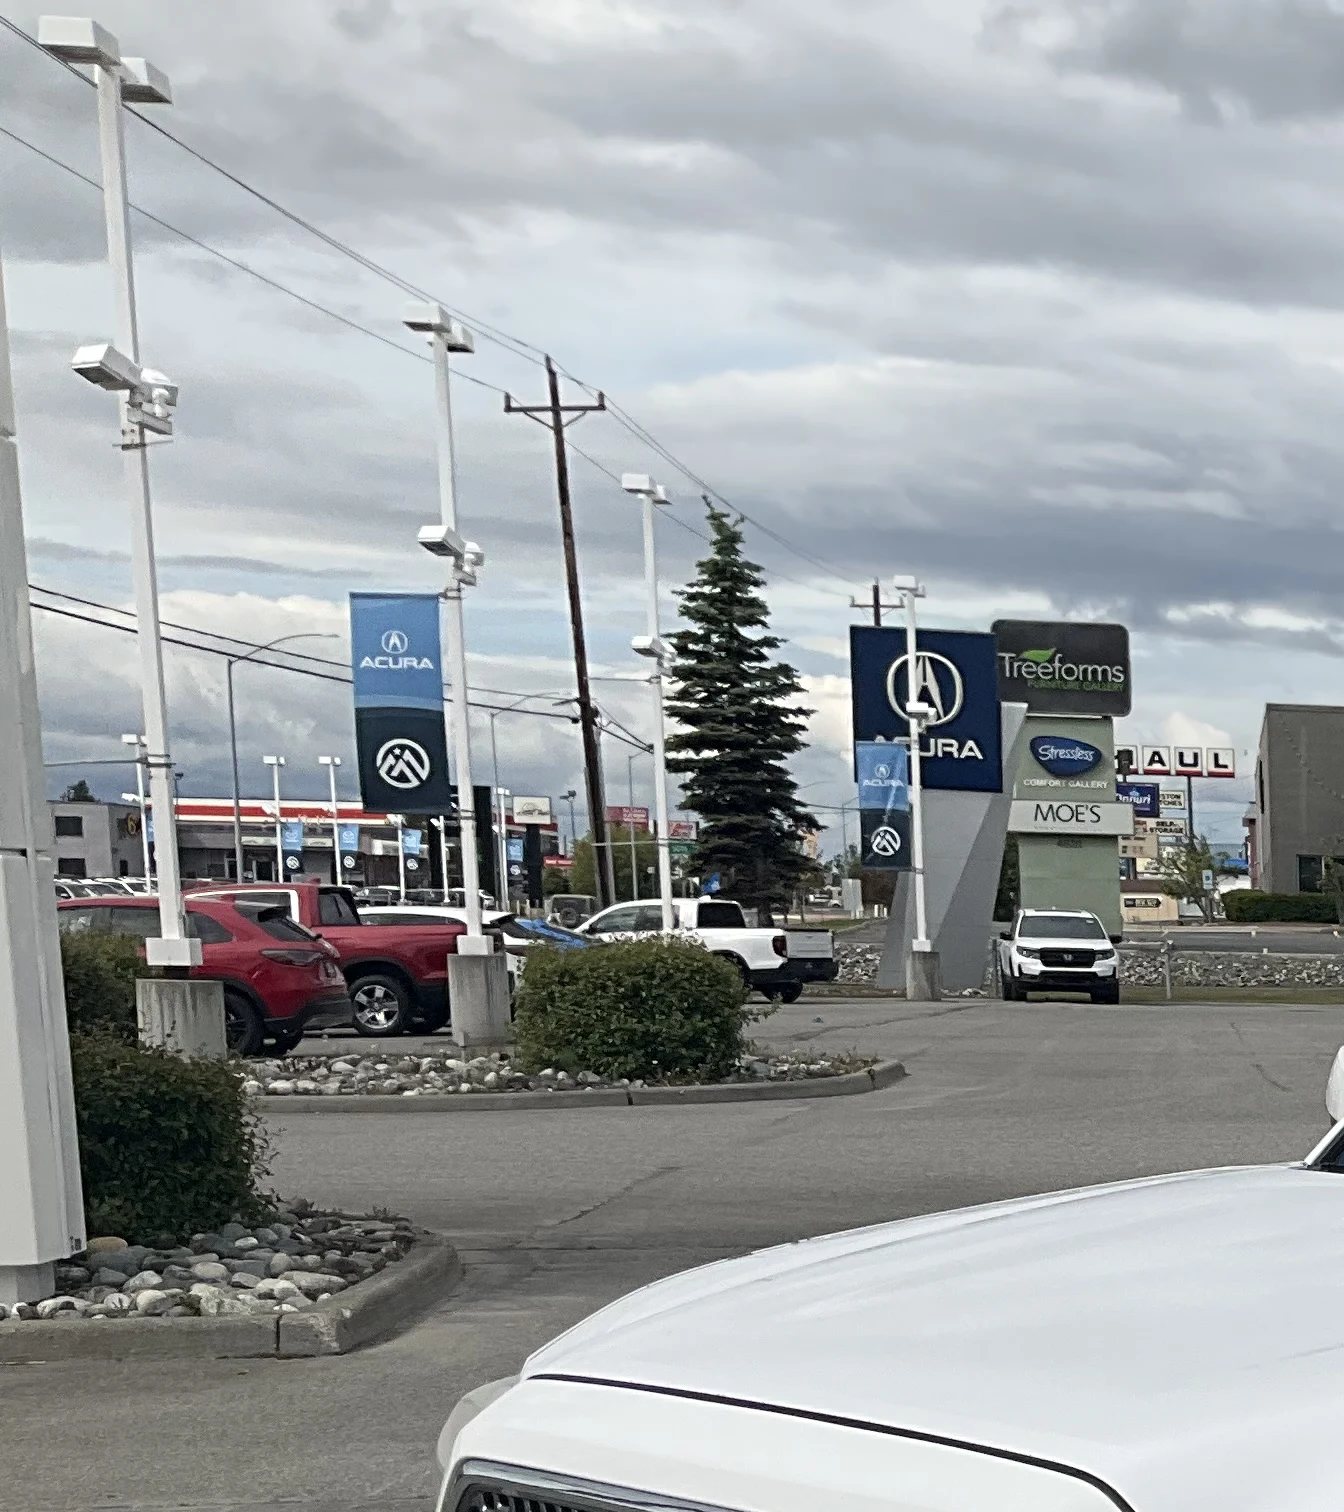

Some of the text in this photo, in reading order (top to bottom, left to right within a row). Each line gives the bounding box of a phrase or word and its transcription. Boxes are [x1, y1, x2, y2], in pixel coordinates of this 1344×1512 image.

[360, 655, 434, 669] ACURA
[998, 652, 1125, 683] Treeforms
[874, 735, 984, 760] URA
[1038, 745, 1095, 761] Stressless
[1117, 749, 1229, 769] AUL
[863, 779, 904, 788] ACURA
[1023, 779, 1109, 789] COMFORT GALLERY
[1034, 803, 1101, 824] MOE'S
